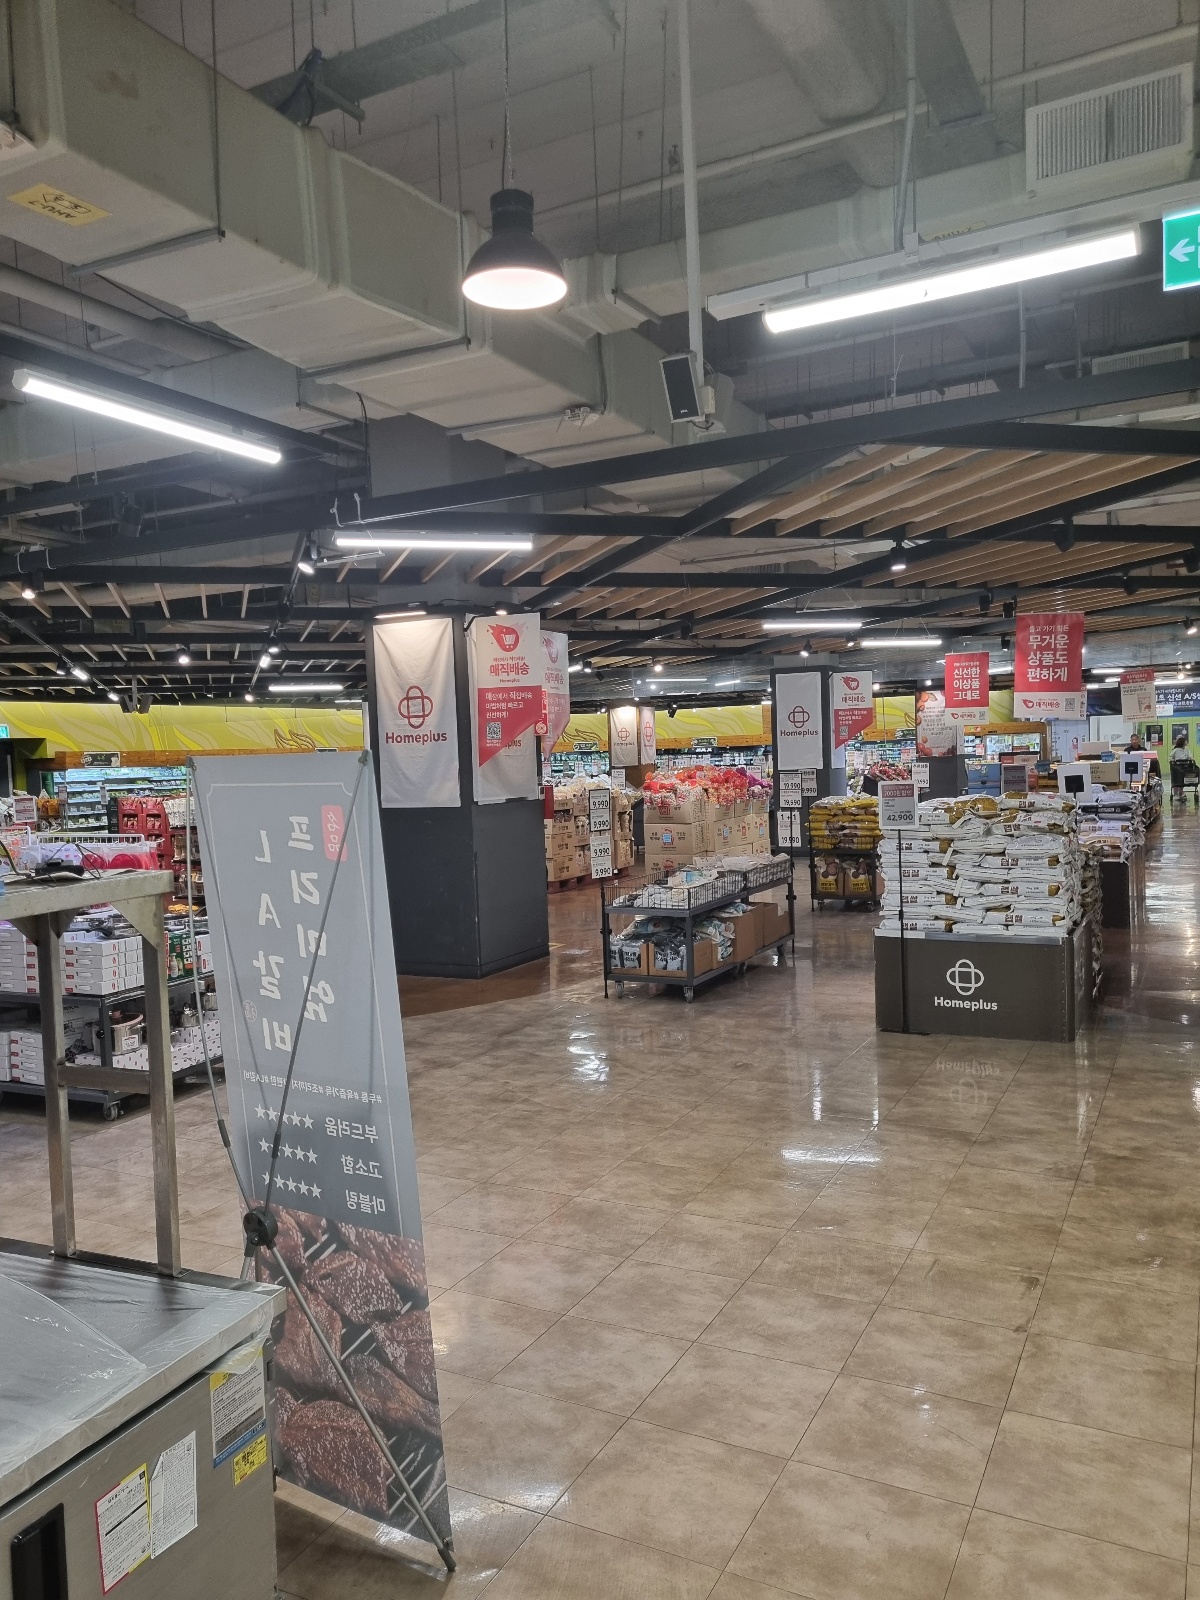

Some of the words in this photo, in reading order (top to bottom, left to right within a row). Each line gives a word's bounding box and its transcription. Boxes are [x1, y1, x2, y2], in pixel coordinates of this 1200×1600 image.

[1028, 634, 1070, 649] 무거운
[1027, 651, 1069, 666] 상품도
[489, 662, 530, 676] 매직배송
[953, 667, 980, 678] 신선한
[1026, 667, 1068, 682] 편하게
[953, 678, 980, 689] 이상품
[953, 690, 980, 701] 그대로
[1167, 693, 1182, 702] 신선
[385, 729, 448, 745] Homeplus
[780, 728, 819, 738] Homeplus
[592, 799, 609, 809] 9,990
[886, 813, 913, 822] 42,900
[593, 819, 610, 829] 9,990
[594, 847, 610, 857] 9,990
[594, 867, 611, 877] 9,990
[934, 996, 998, 1012] Homeplus
